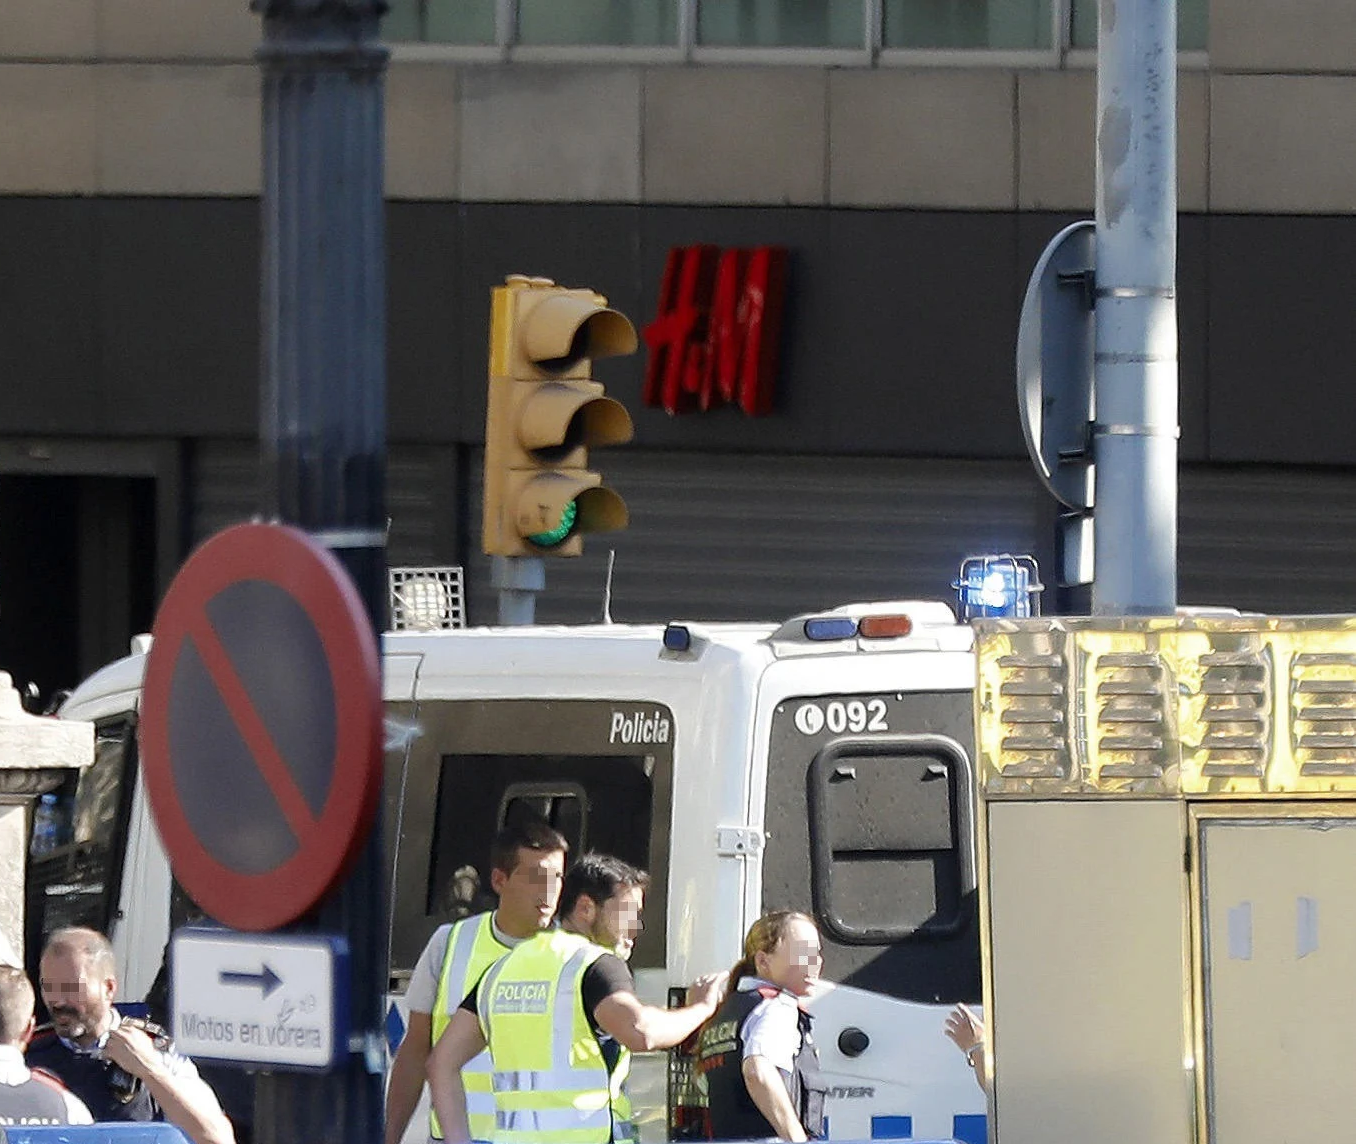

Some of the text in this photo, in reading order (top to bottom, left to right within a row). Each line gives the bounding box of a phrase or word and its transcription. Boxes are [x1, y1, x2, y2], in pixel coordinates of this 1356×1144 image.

[610, 712, 670, 743] Policia
[826, 700, 889, 732] 092
[496, 984, 547, 1000] POLICIA
[181, 1013, 234, 1041] Motos
[240, 1023, 261, 1045] en
